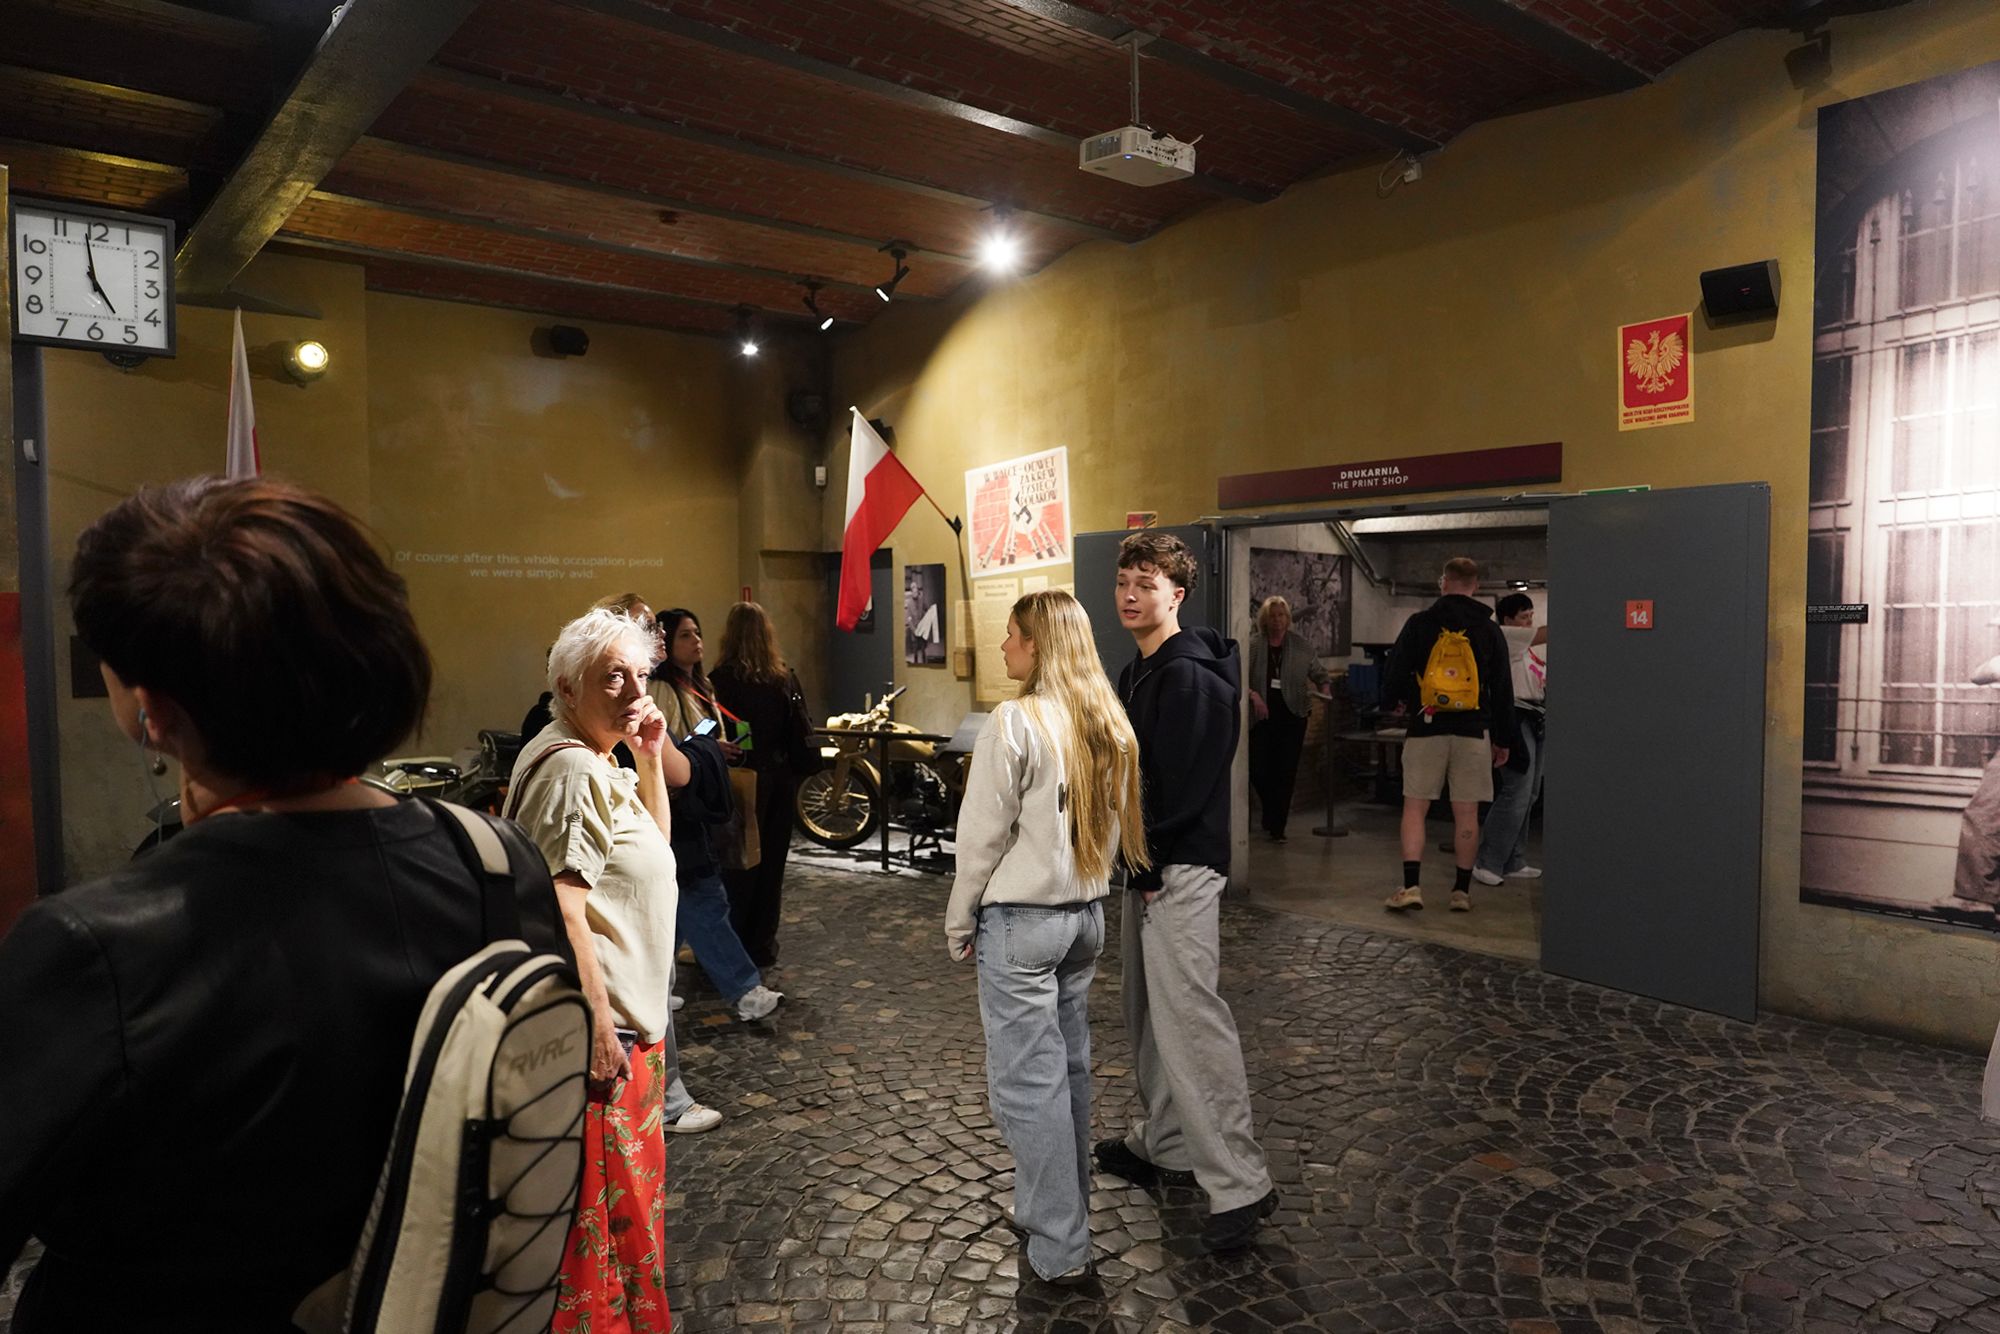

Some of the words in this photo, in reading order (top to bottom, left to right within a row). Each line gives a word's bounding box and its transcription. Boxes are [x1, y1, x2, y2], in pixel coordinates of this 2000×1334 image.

[54, 217, 67, 237] 11
[86, 221, 109, 243] 12
[125, 227, 130, 246] 1
[23, 233, 47, 255] 10
[143, 250, 160, 270] 2
[25, 265, 43, 285] 9
[144, 280, 160, 299] 3
[25, 294, 44, 315] 8
[56, 317, 69, 337] 7
[143, 308, 161, 328] 4
[86, 321, 104, 341] 6
[122, 325, 139, 345] 5
[1332, 481, 1349, 490] THE
[1352, 478, 1379, 489] PRINT
[1382, 475, 1409, 486] SHOP
[1340, 466, 1400, 480] DRUKARNIA
[395, 551, 411, 562] Of
[415, 553, 459, 563] course
[463, 552, 493, 564] after
[497, 553, 520, 565] this
[524, 553, 559, 565] whole
[563, 555, 625, 568] occupation
[628, 557, 664, 569] period
[470, 569, 488, 578] we
[492, 569, 522, 578] were
[526, 568, 565, 580] simply
[1630, 611, 1648, 625] 14
[508, 1028, 578, 1077] RVRC
